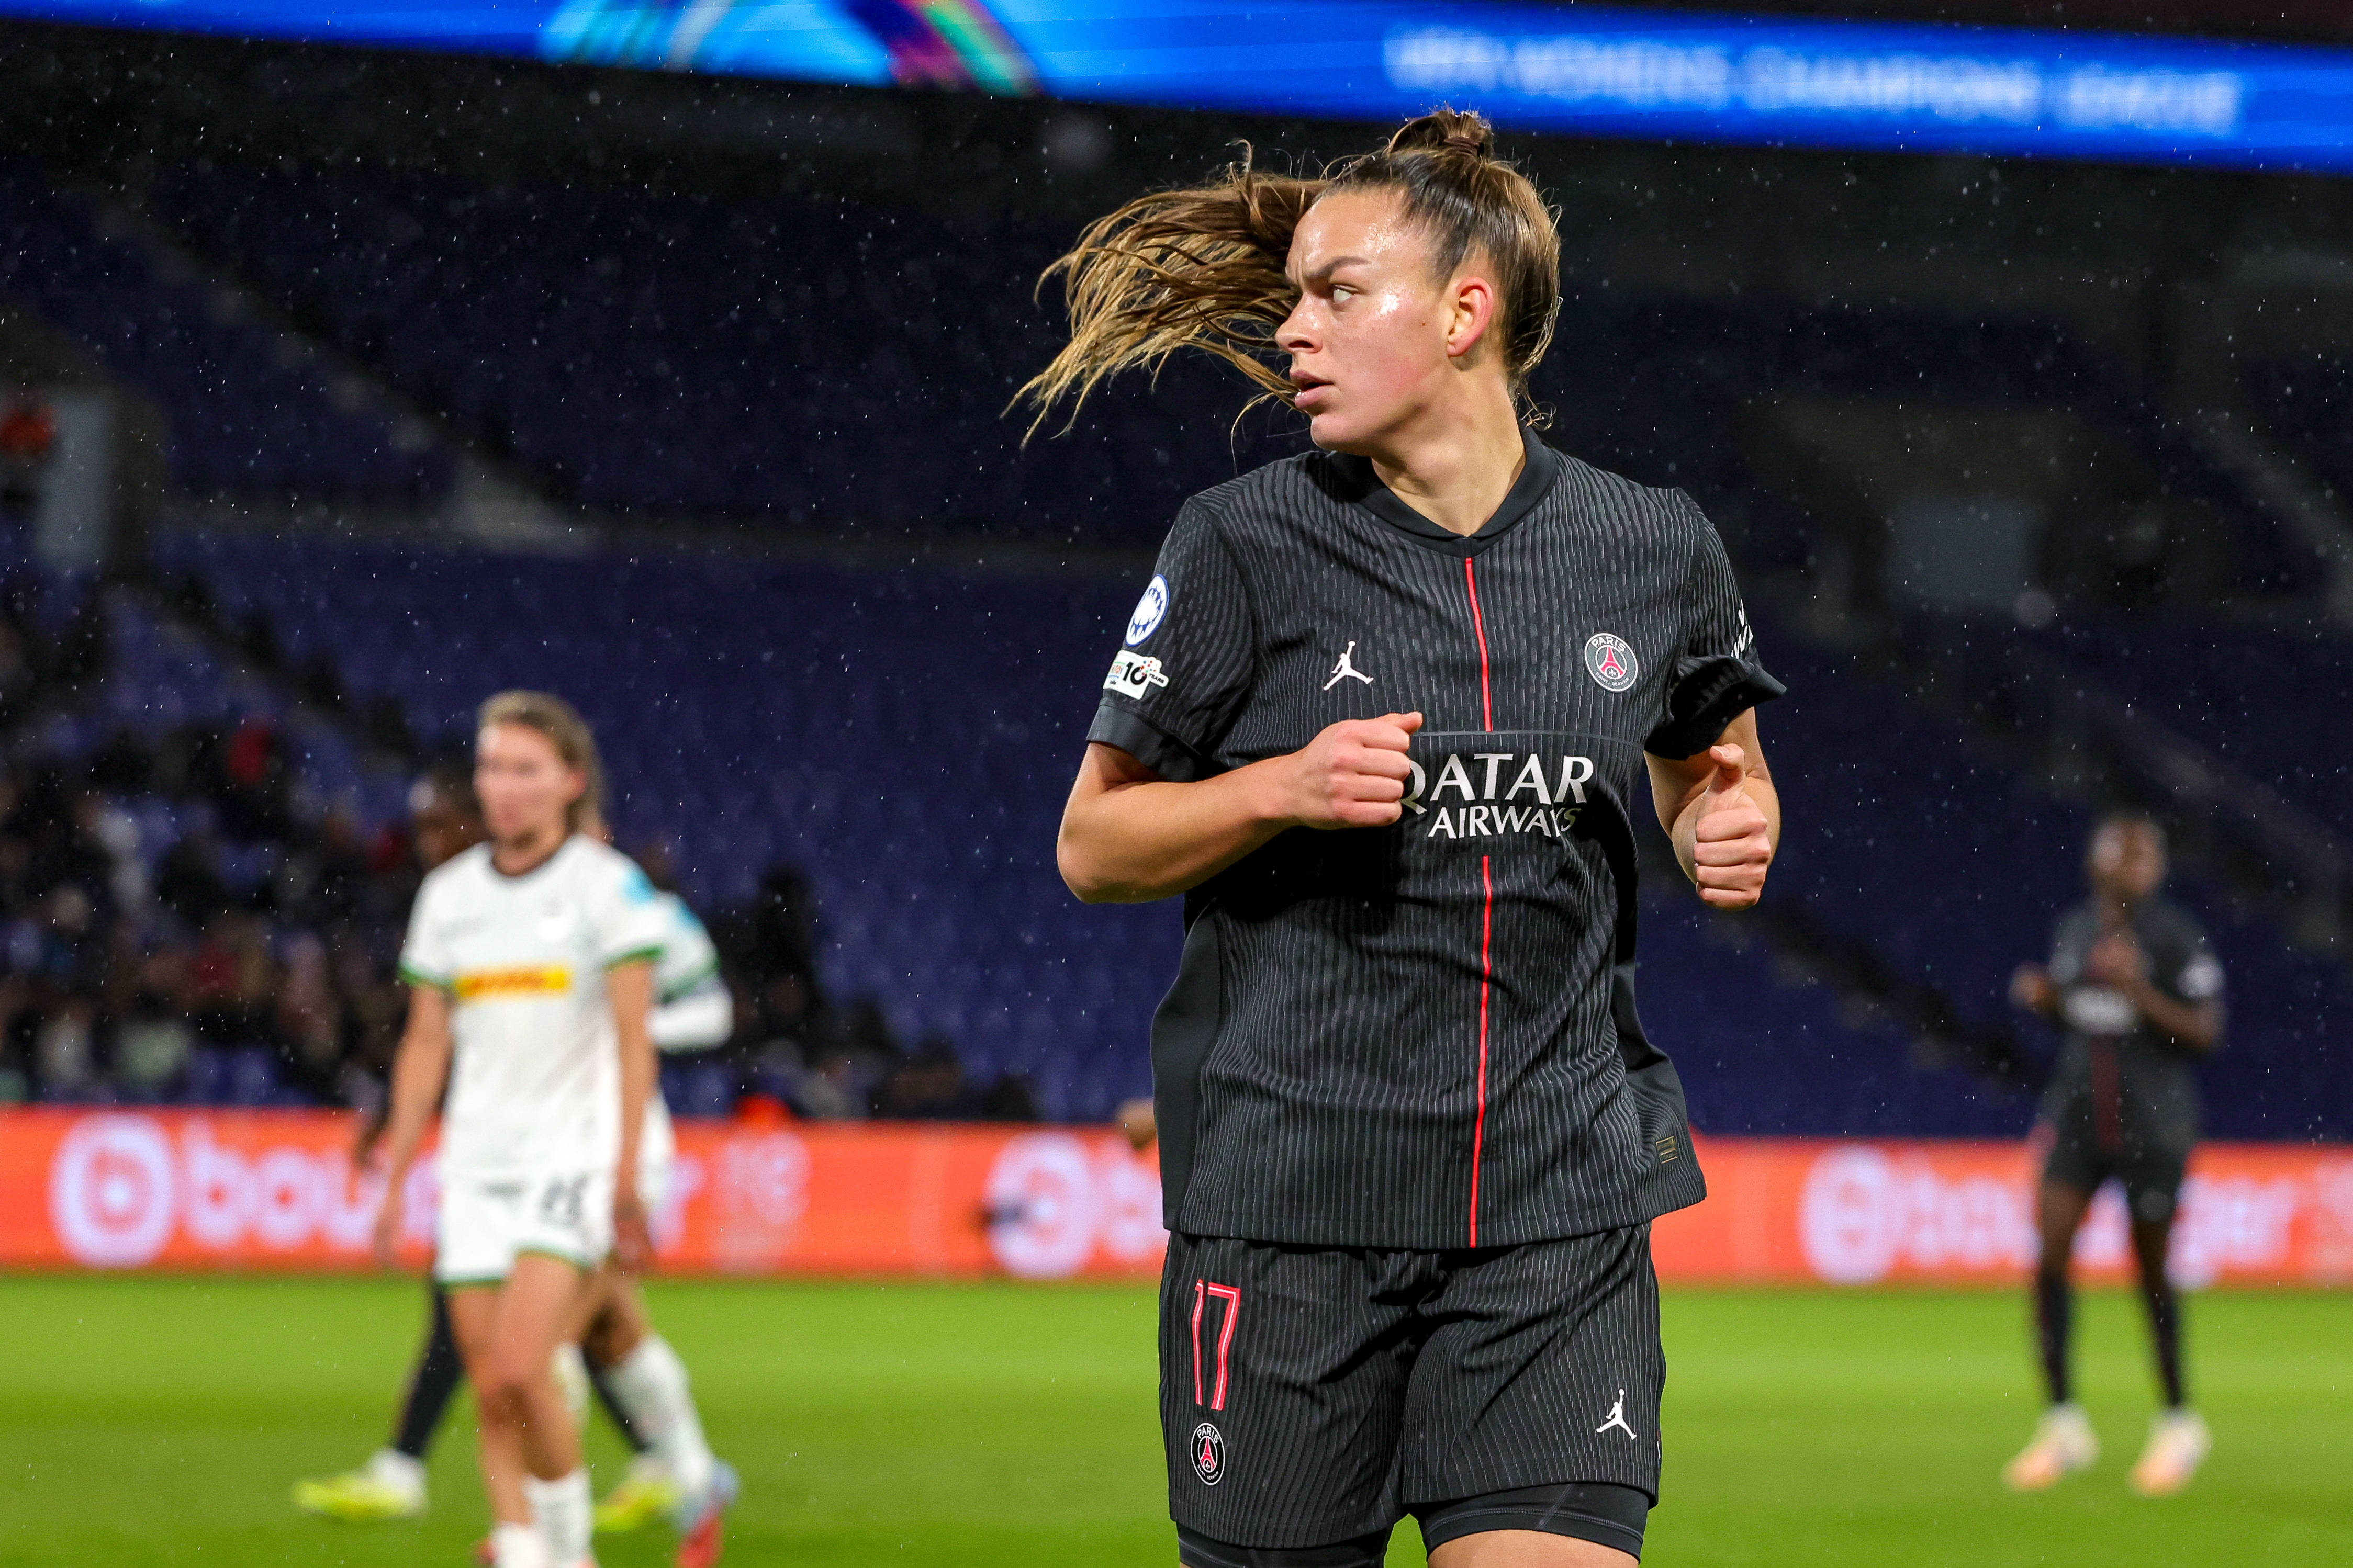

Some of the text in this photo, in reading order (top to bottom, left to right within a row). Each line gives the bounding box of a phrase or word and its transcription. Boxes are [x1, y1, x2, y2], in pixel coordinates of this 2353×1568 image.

[1591, 636, 1626, 652] PARIS
[1428, 805, 1582, 839] AIRWAYS
[1191, 1278, 1241, 1411] 17
[1196, 1426, 1219, 1444] PARIS
